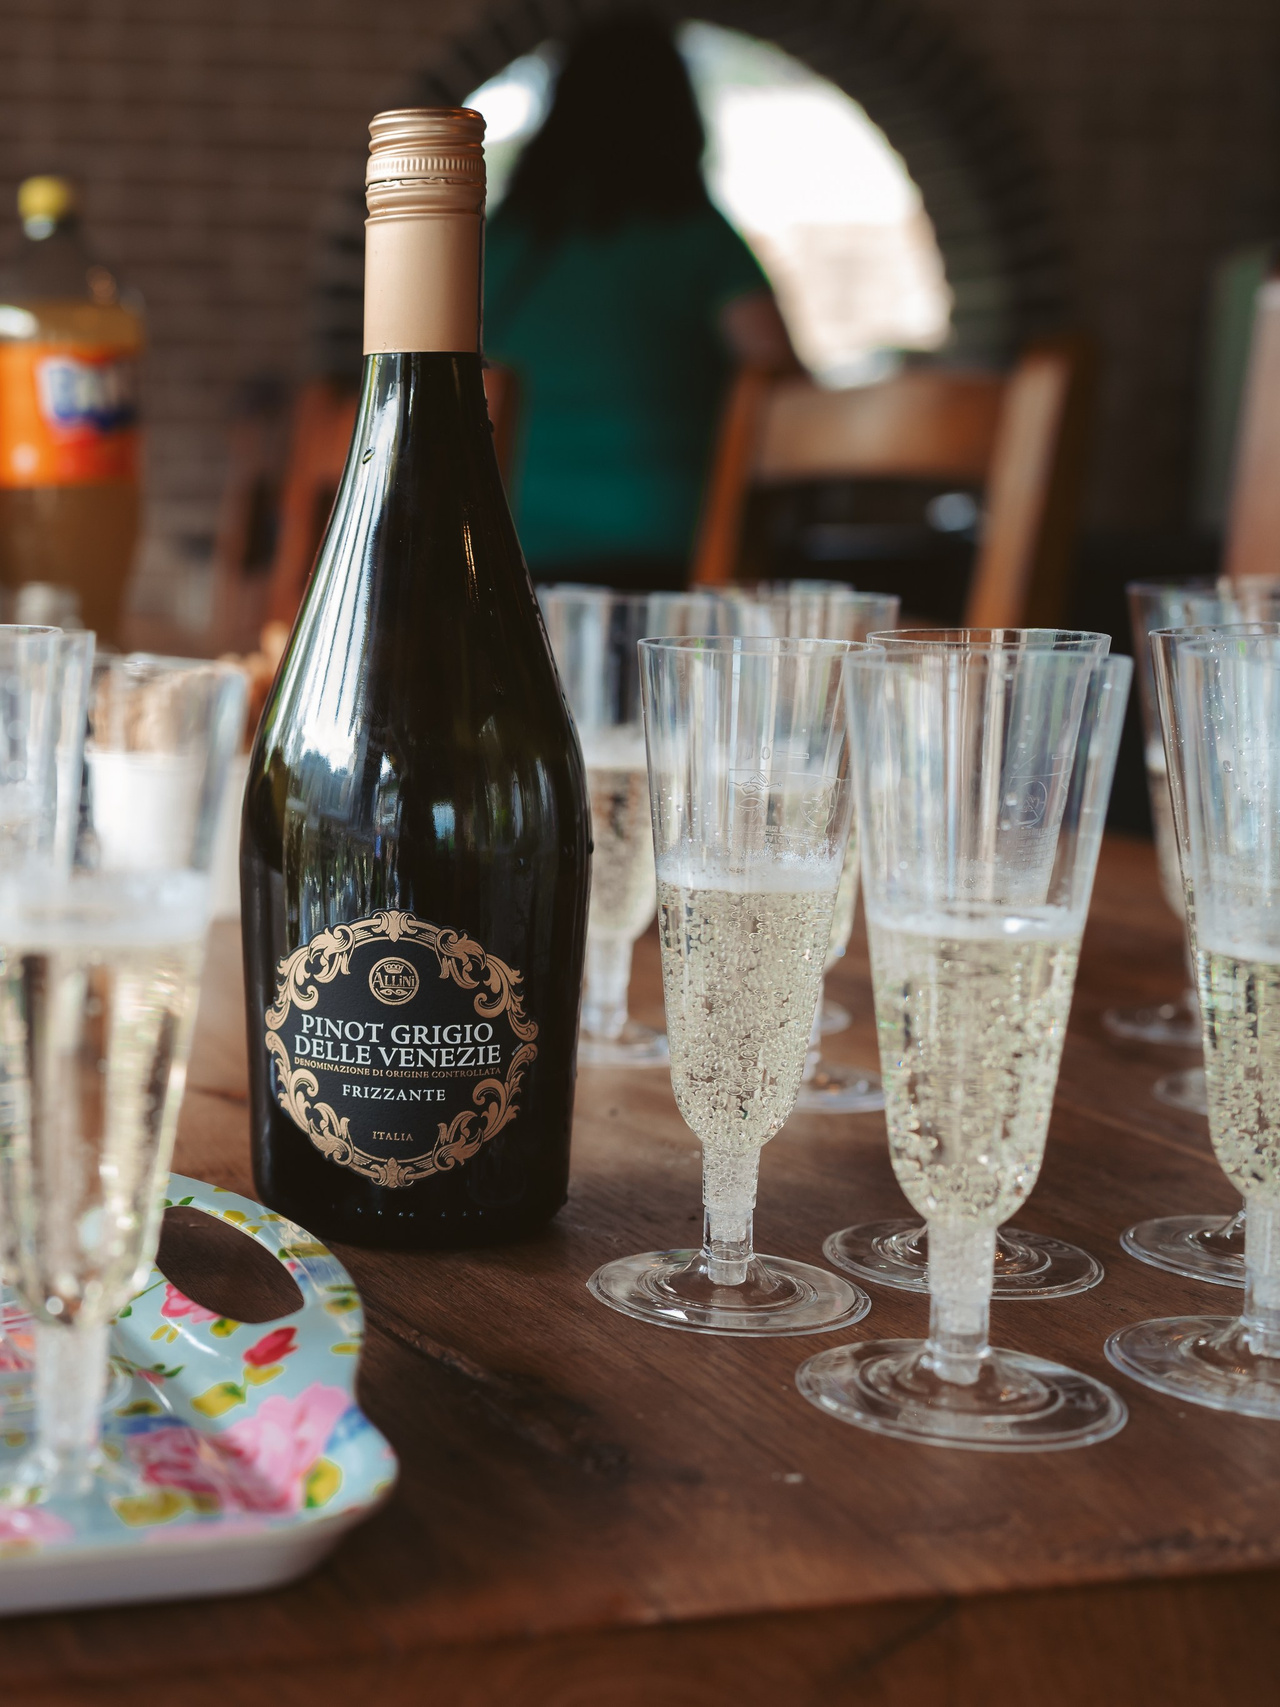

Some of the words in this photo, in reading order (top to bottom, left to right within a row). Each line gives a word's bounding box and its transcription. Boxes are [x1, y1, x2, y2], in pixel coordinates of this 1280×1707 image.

[301, 1013, 384, 1043] PINOT
[390, 1022, 494, 1045] GRIGIO
[294, 1034, 372, 1065] DELLE
[377, 1044, 501, 1068] VENEZIE
[294, 1056, 370, 1076] DENOMINAZIONE
[372, 1068, 384, 1077] DI
[385, 1069, 430, 1079] ORIGINE
[431, 1066, 502, 1079] CONTROLLATA
[342, 1083, 446, 1102] FRIZZANTE
[372, 1130, 414, 1141] ITALIA
